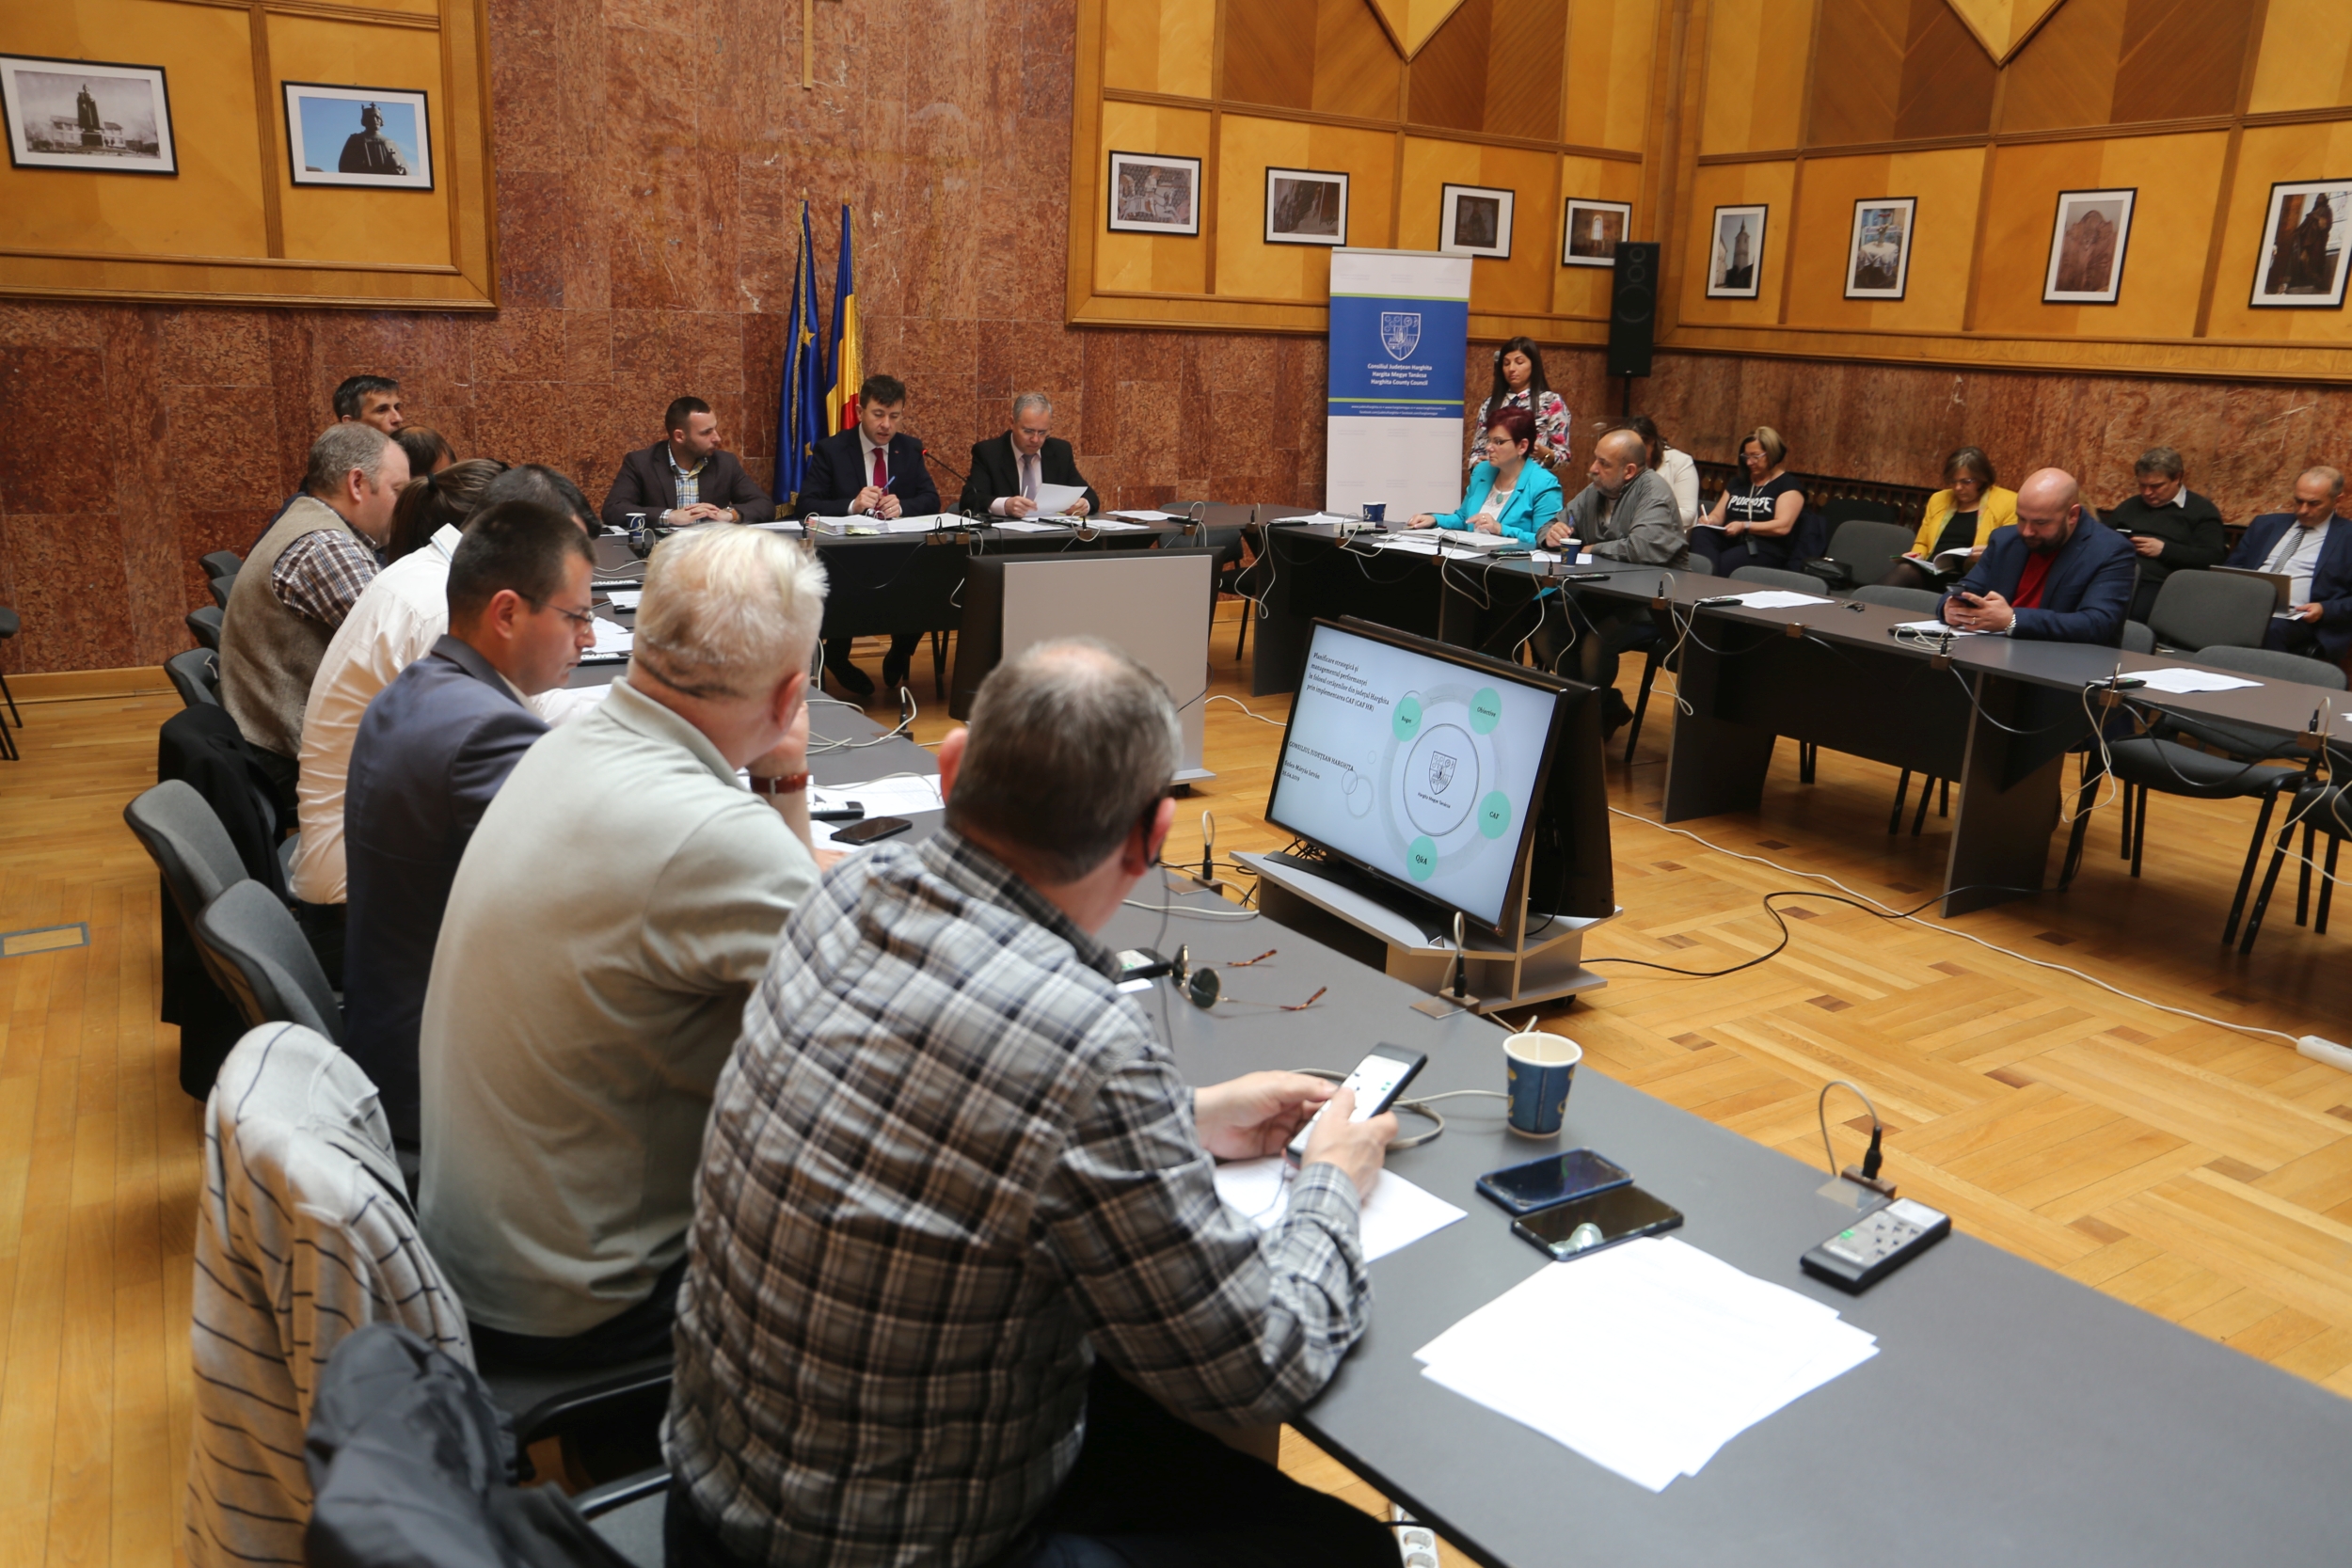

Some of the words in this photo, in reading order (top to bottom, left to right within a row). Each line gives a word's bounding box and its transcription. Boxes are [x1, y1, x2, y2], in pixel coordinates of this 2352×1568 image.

[1727, 495, 1774, 513] PUROSE
[1313, 652, 1335, 664] Planificare
[1311, 664, 1341, 677] managementul
[1370, 693, 1389, 705] Harghita
[1289, 741, 1311, 754] CONSILIUL
[1489, 810, 1500, 820] CAF
[1415, 854, 1428, 865] Q&A
